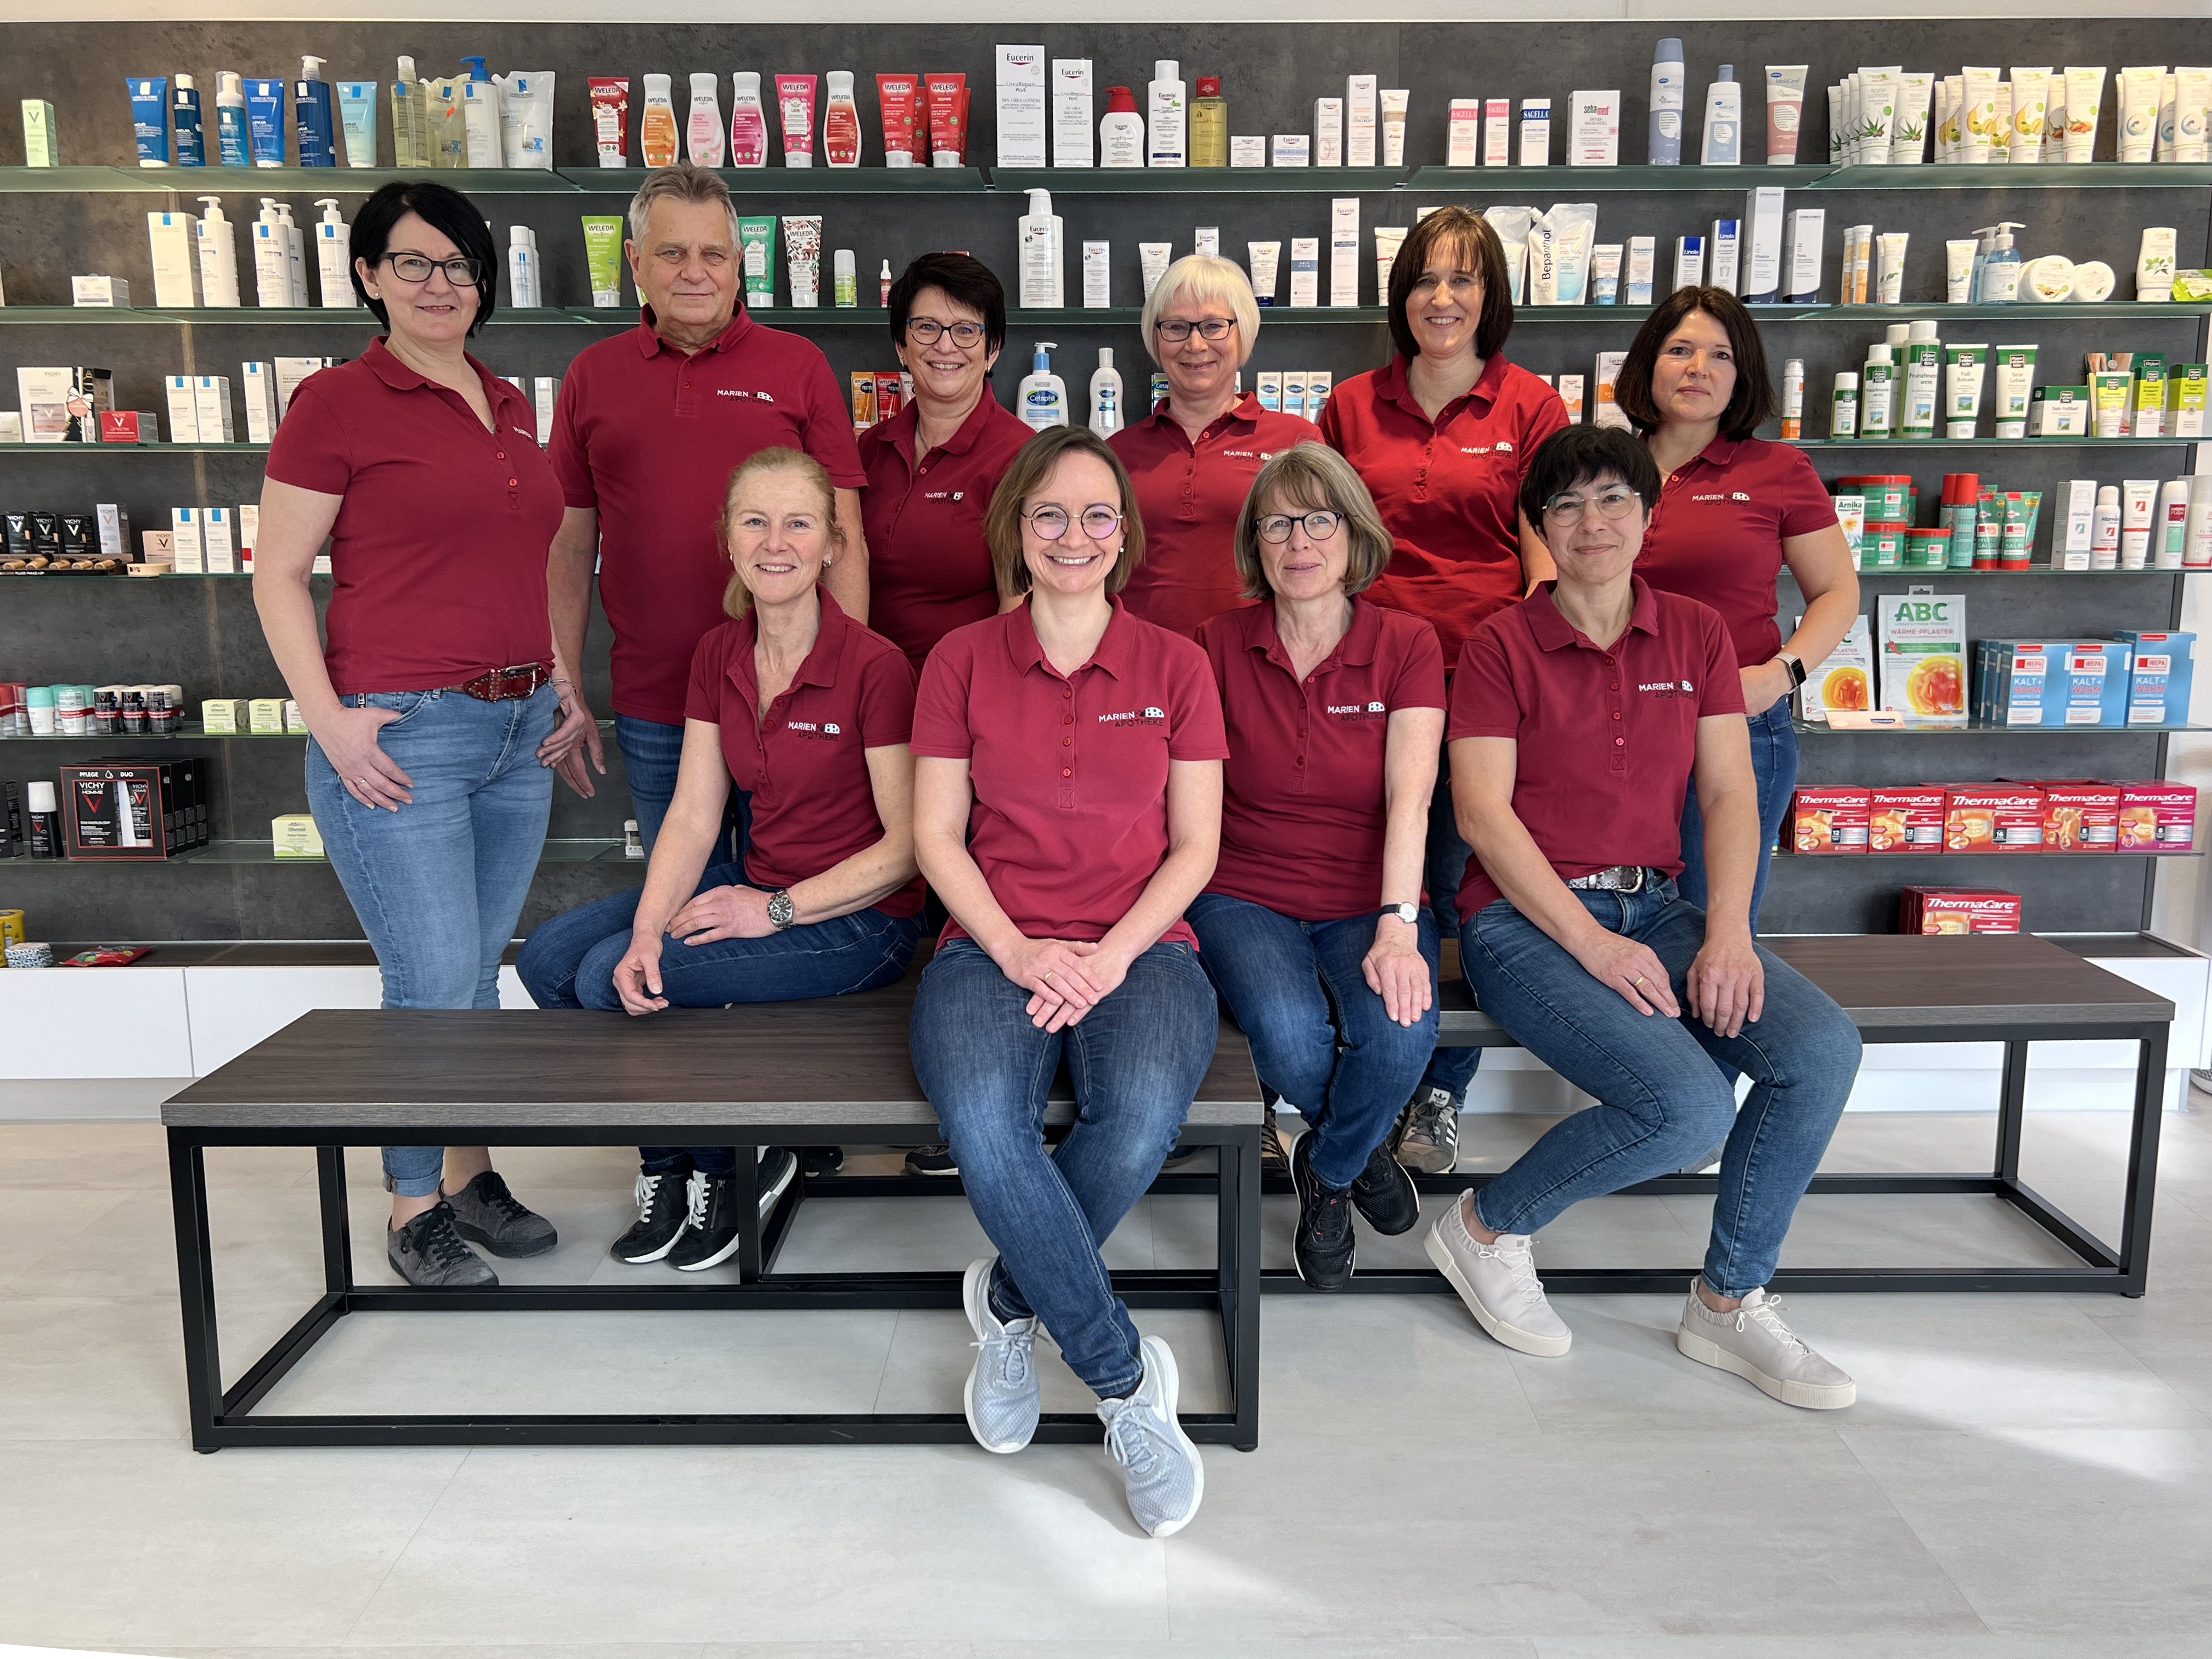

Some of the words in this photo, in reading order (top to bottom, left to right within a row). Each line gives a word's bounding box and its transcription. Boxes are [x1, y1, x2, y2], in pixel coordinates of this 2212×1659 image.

[1007, 53, 1035, 61] Eucerin
[1523, 110, 1548, 119] SAGELLA
[1542, 228, 1553, 280] Bepanthol
[1894, 602, 1949, 622] ABC
[1638, 682, 1674, 692] MARIEN
[1328, 705, 1359, 714] MARIEN
[1099, 711, 1135, 723] MARIEN
[1340, 713, 1385, 721] APOTHEKE
[788, 721, 817, 731] MARIEN
[1114, 718, 1164, 727] APOTHEKE
[797, 732, 839, 742] APOTHEKE
[1800, 795, 1868, 804] ThermaCare
[1874, 795, 1942, 804] ThermaCare
[1953, 795, 2041, 806] ThermaCare
[2049, 793, 2117, 802] ThermaCare
[2124, 793, 2193, 802] ThermaCare
[1927, 898, 2016, 910] ThermaCare
